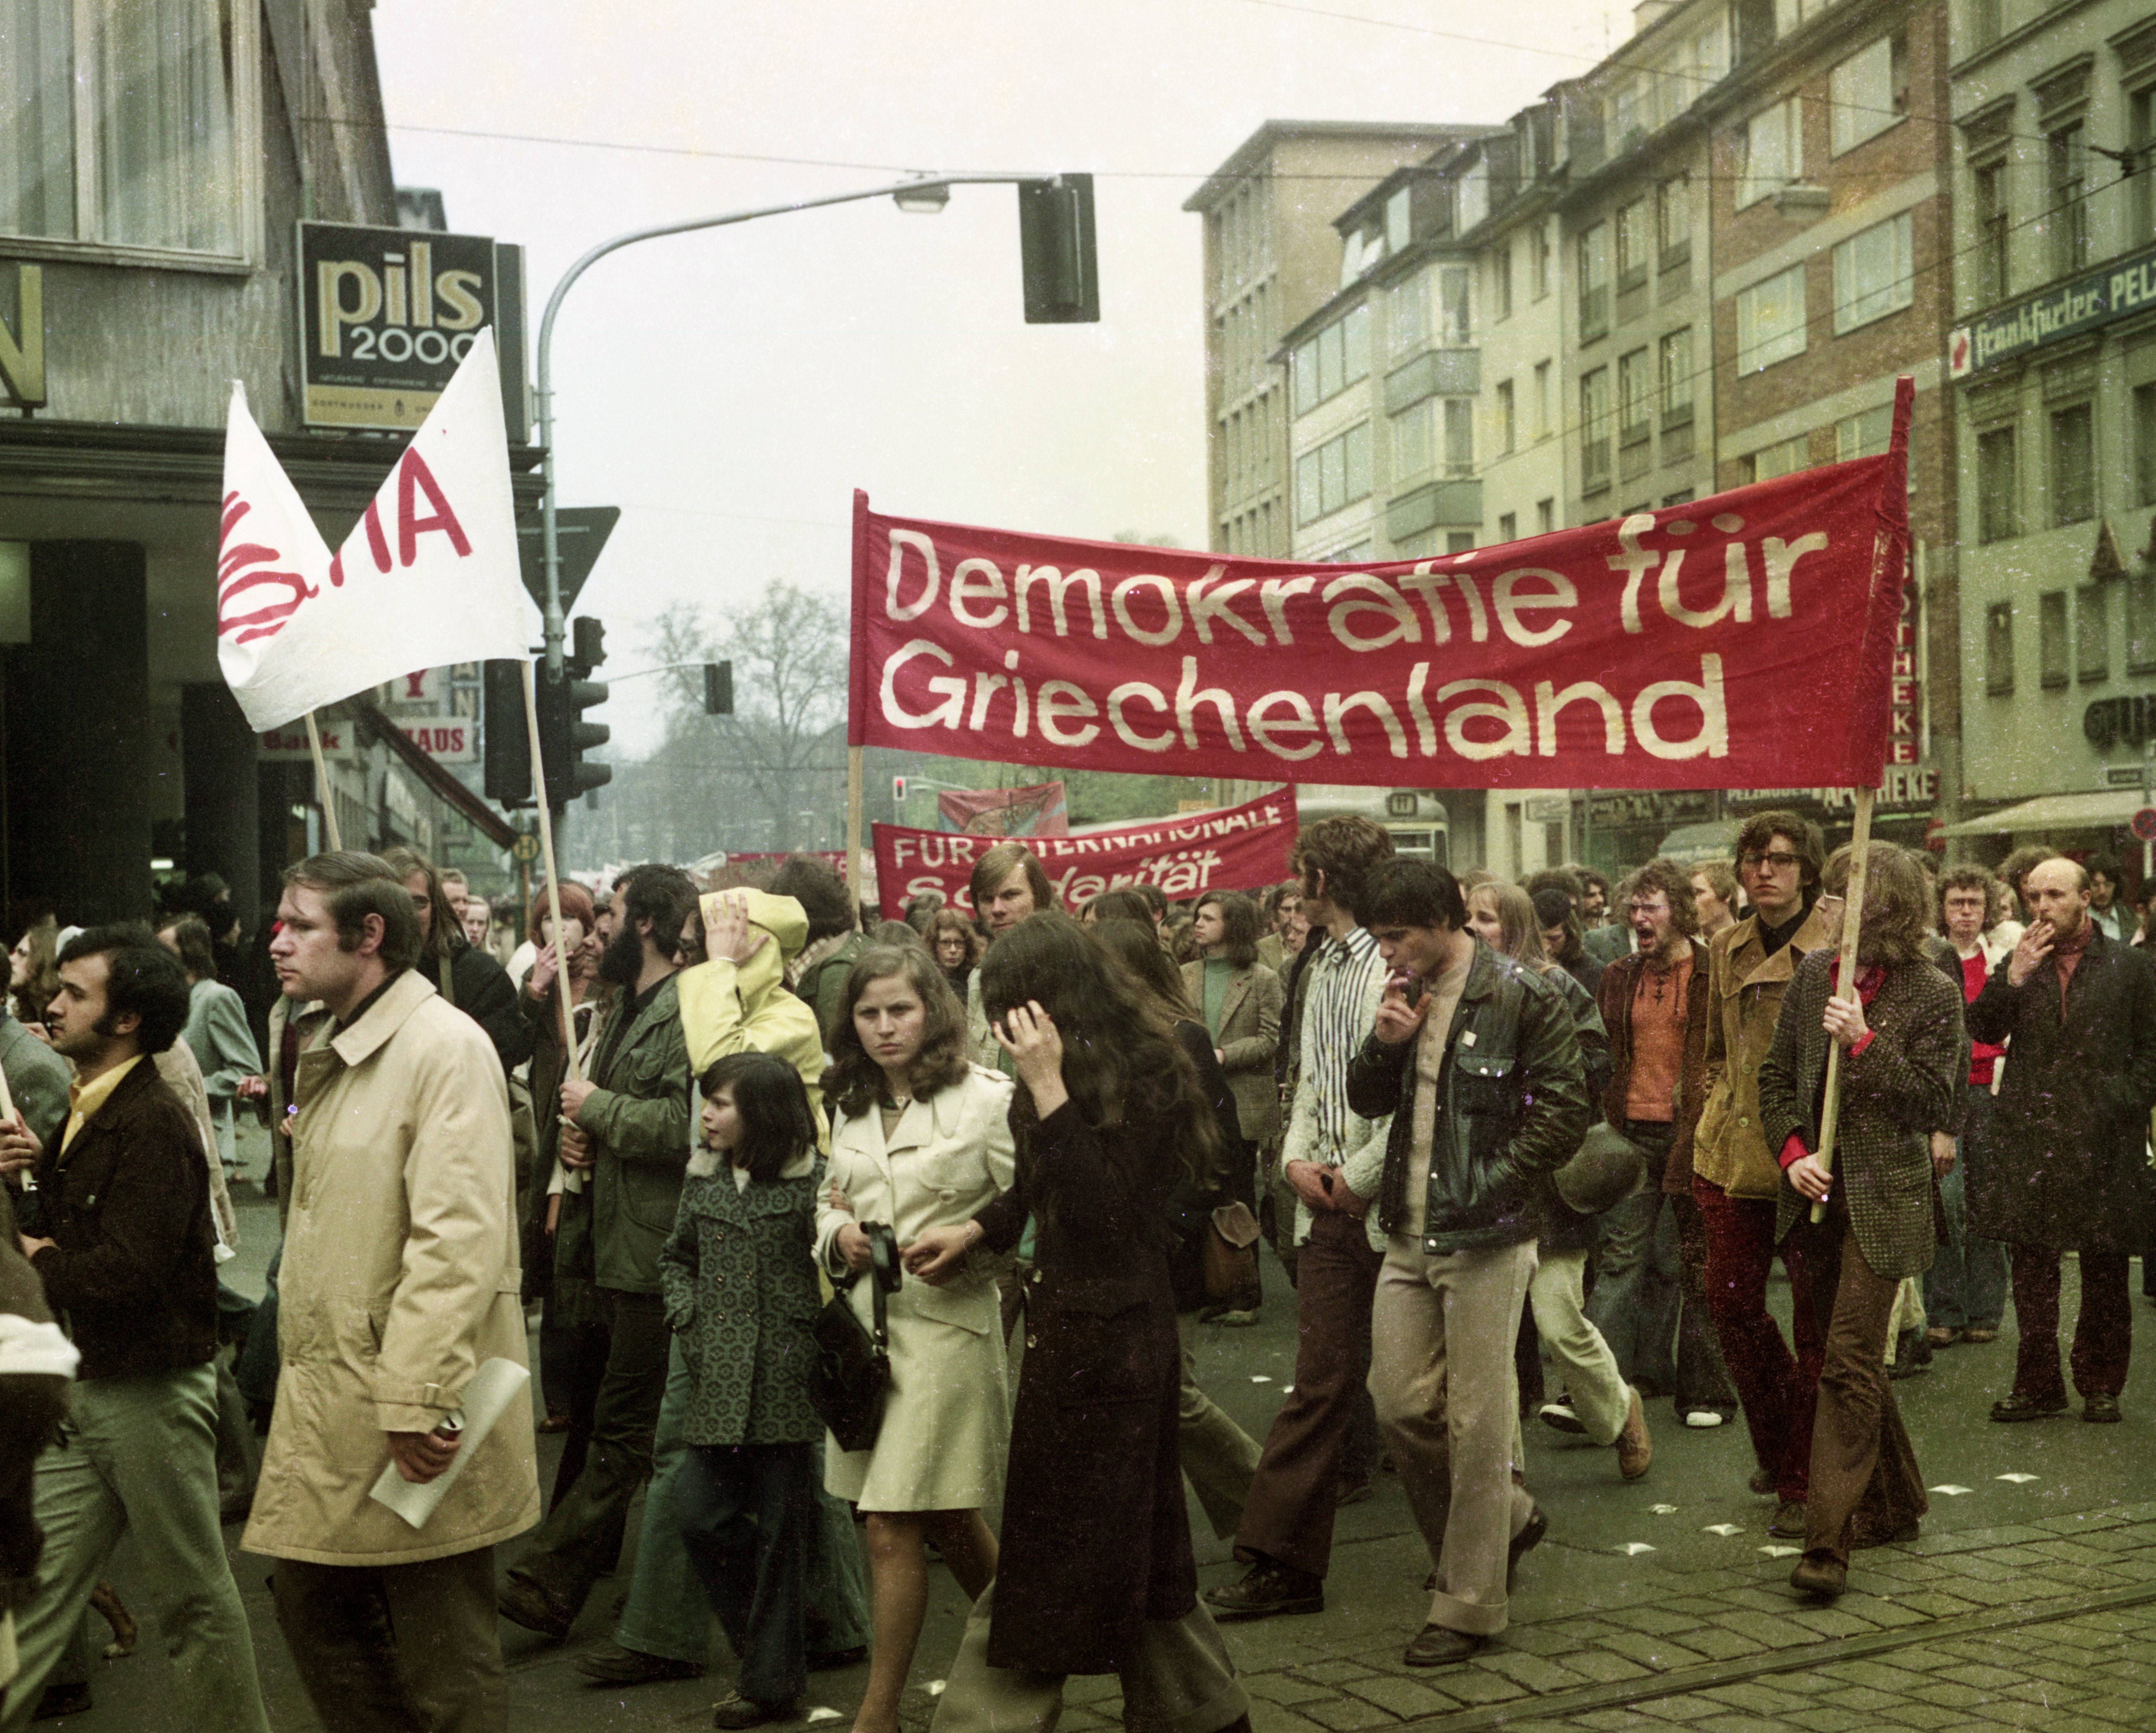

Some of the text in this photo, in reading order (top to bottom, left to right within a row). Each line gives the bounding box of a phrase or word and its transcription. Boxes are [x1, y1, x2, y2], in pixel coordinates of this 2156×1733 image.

[317, 240, 484, 358] pils
[2110, 260, 2156, 312] PEL
[886, 513, 1828, 653] Demokratie für
[402, 728, 464, 753] AUS
[879, 638, 1729, 761] Griechenland
[894, 834, 975, 869] FÜR
